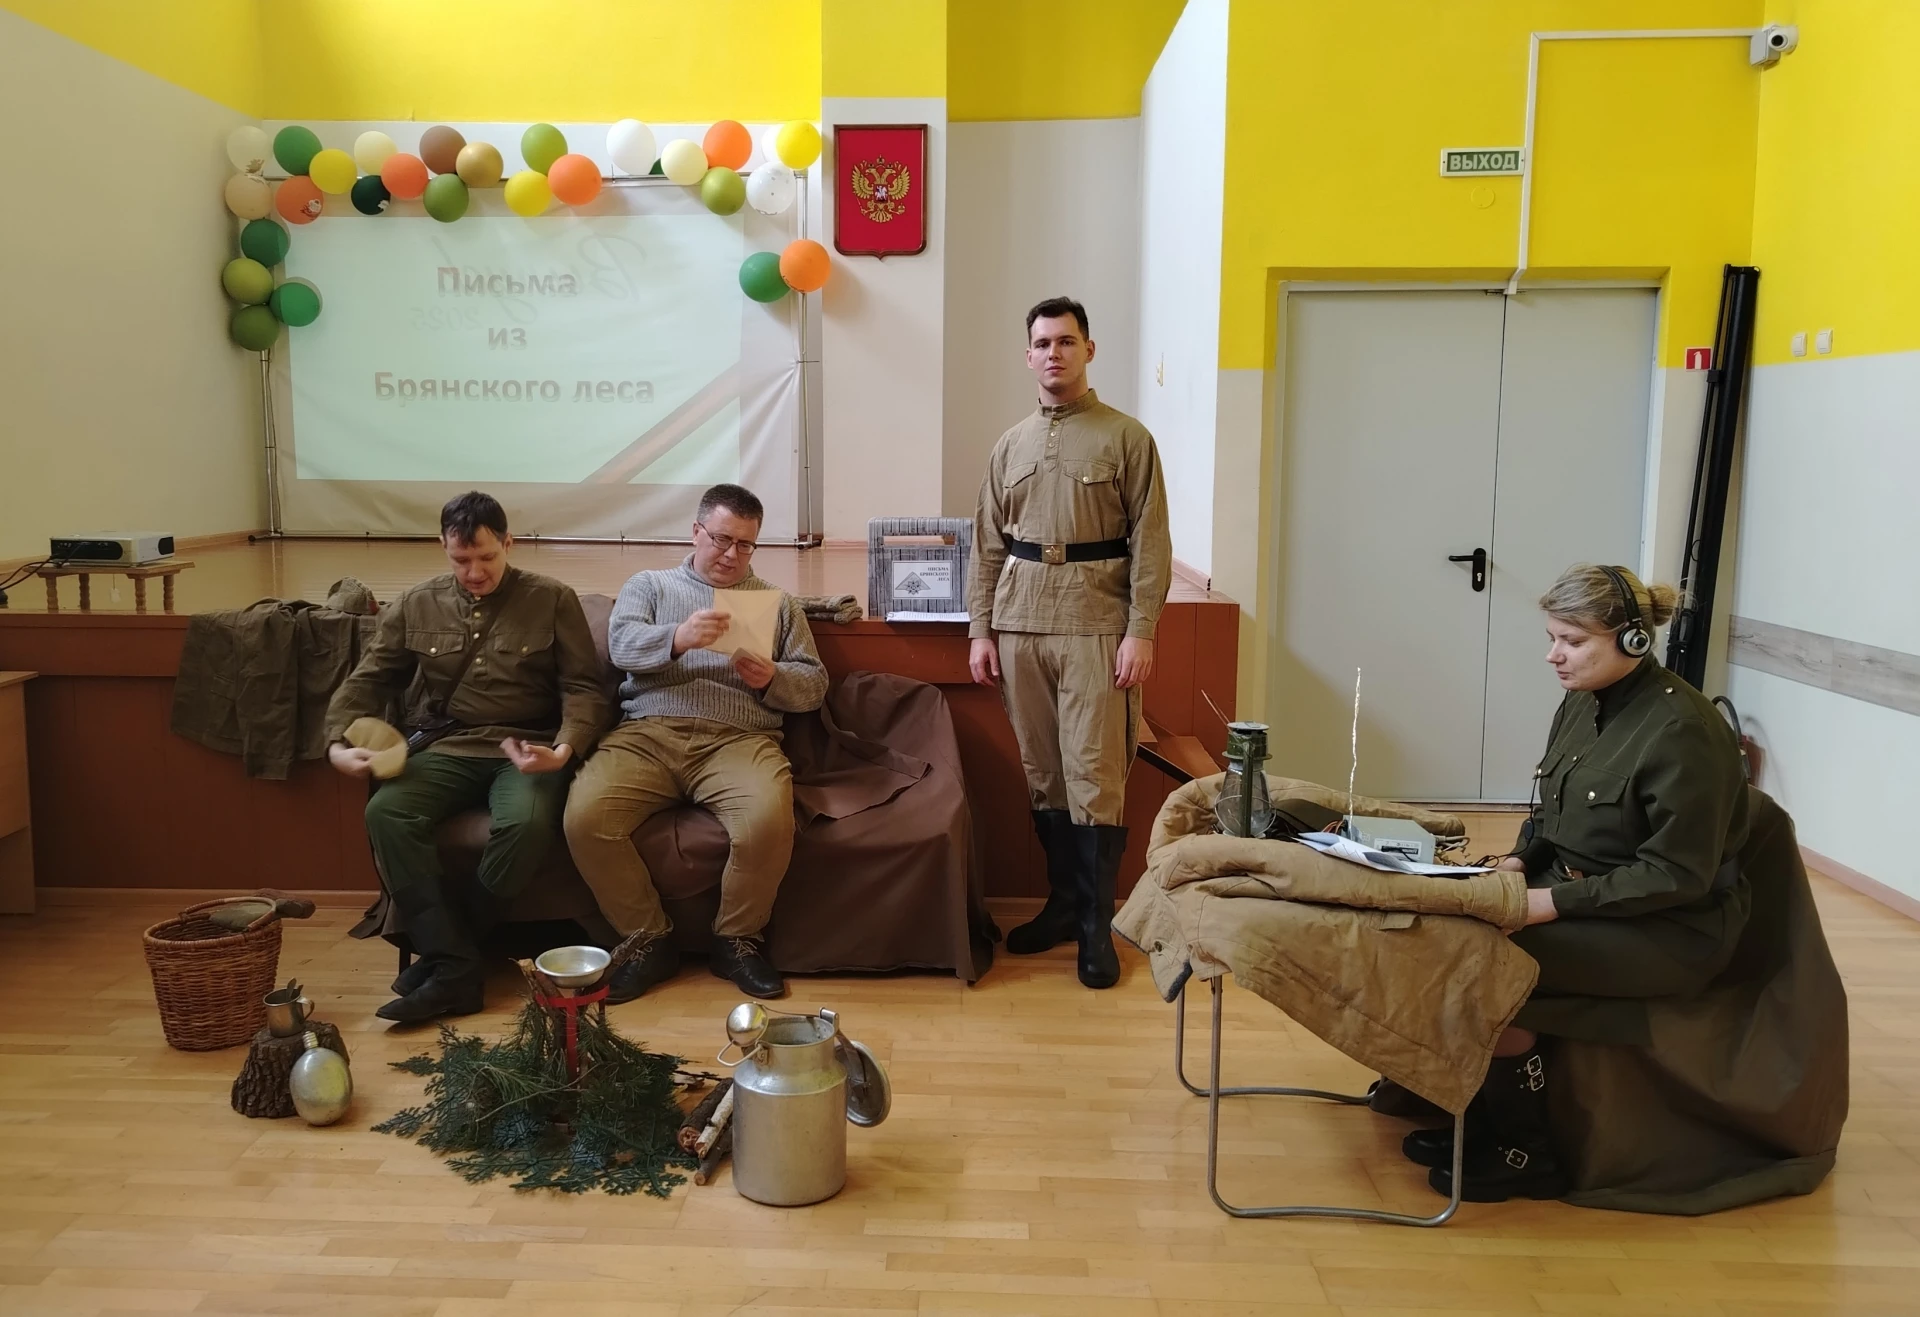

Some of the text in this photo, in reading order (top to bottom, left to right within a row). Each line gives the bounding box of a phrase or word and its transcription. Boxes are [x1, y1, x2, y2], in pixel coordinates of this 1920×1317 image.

[1449, 153, 1516, 171] ВЫХОД
[437, 266, 578, 298] Письма
[488, 327, 528, 350] из
[374, 371, 655, 407] Брянского леса
